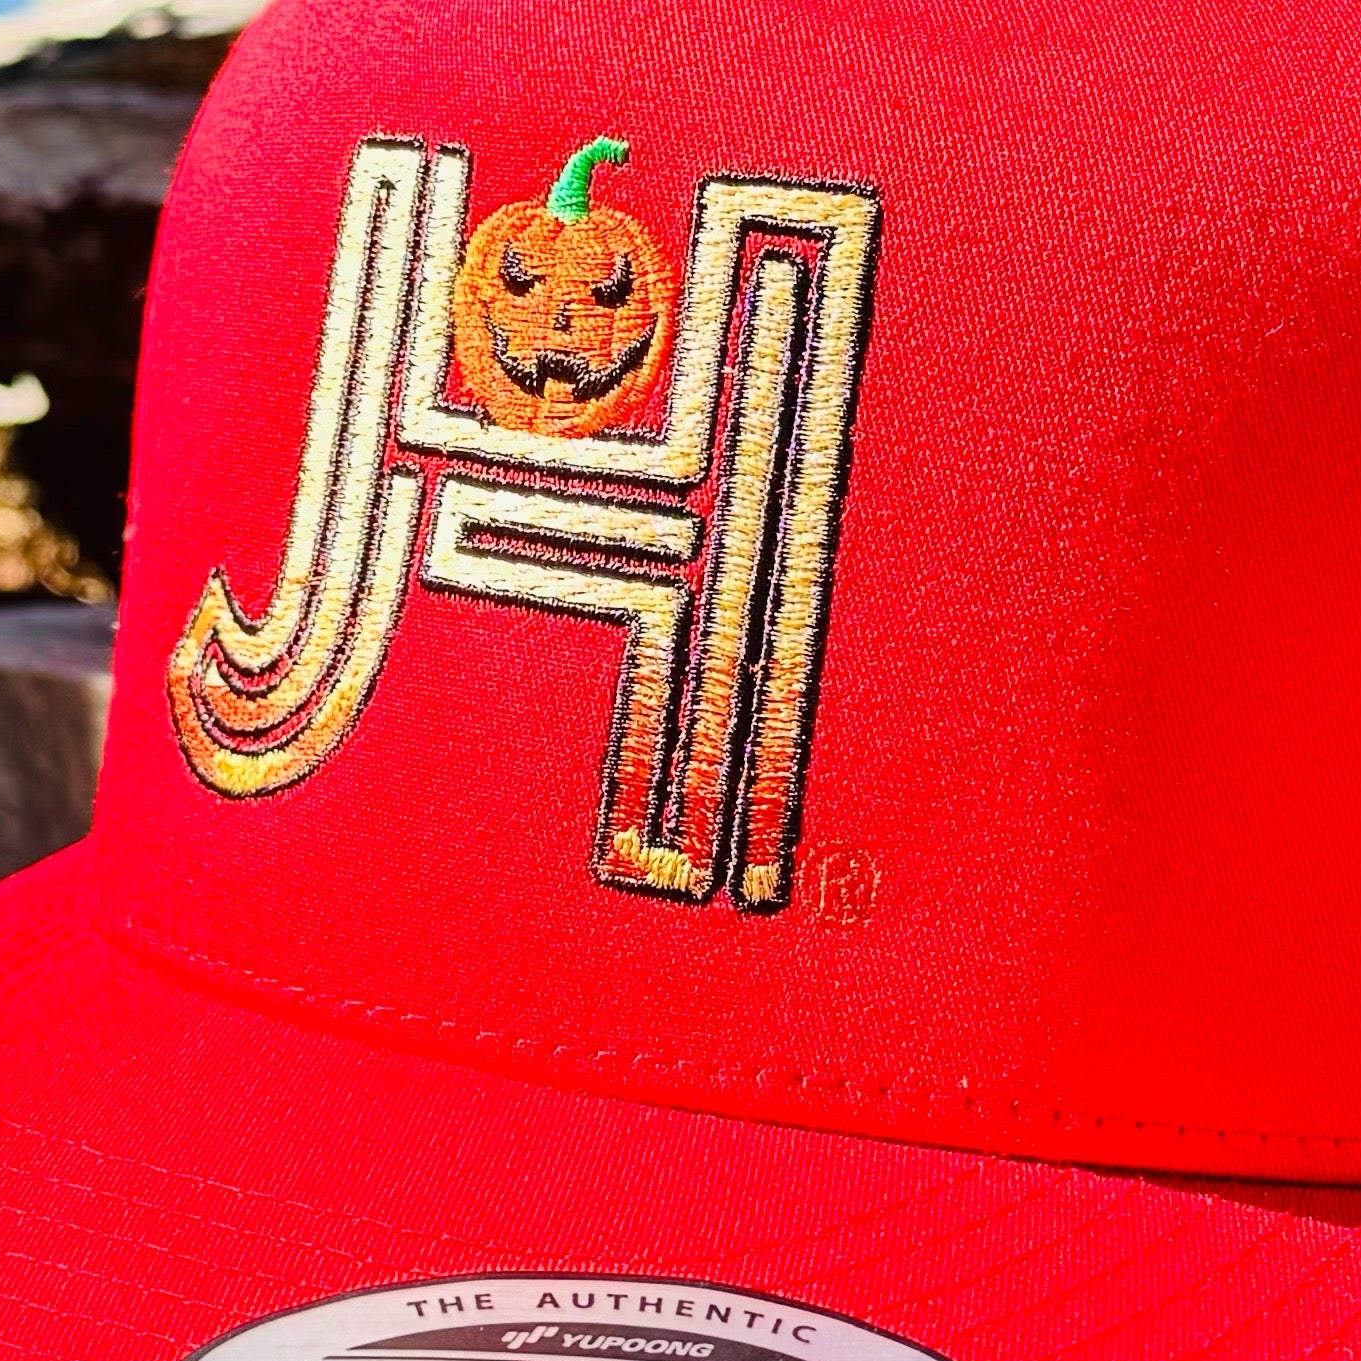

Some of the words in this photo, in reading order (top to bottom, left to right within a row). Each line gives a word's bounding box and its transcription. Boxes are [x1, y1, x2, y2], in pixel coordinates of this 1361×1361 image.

[406, 1293, 495, 1317] THE
[536, 1291, 818, 1344] AUTHENTIC
[561, 1333, 715, 1358] YUPOONG
